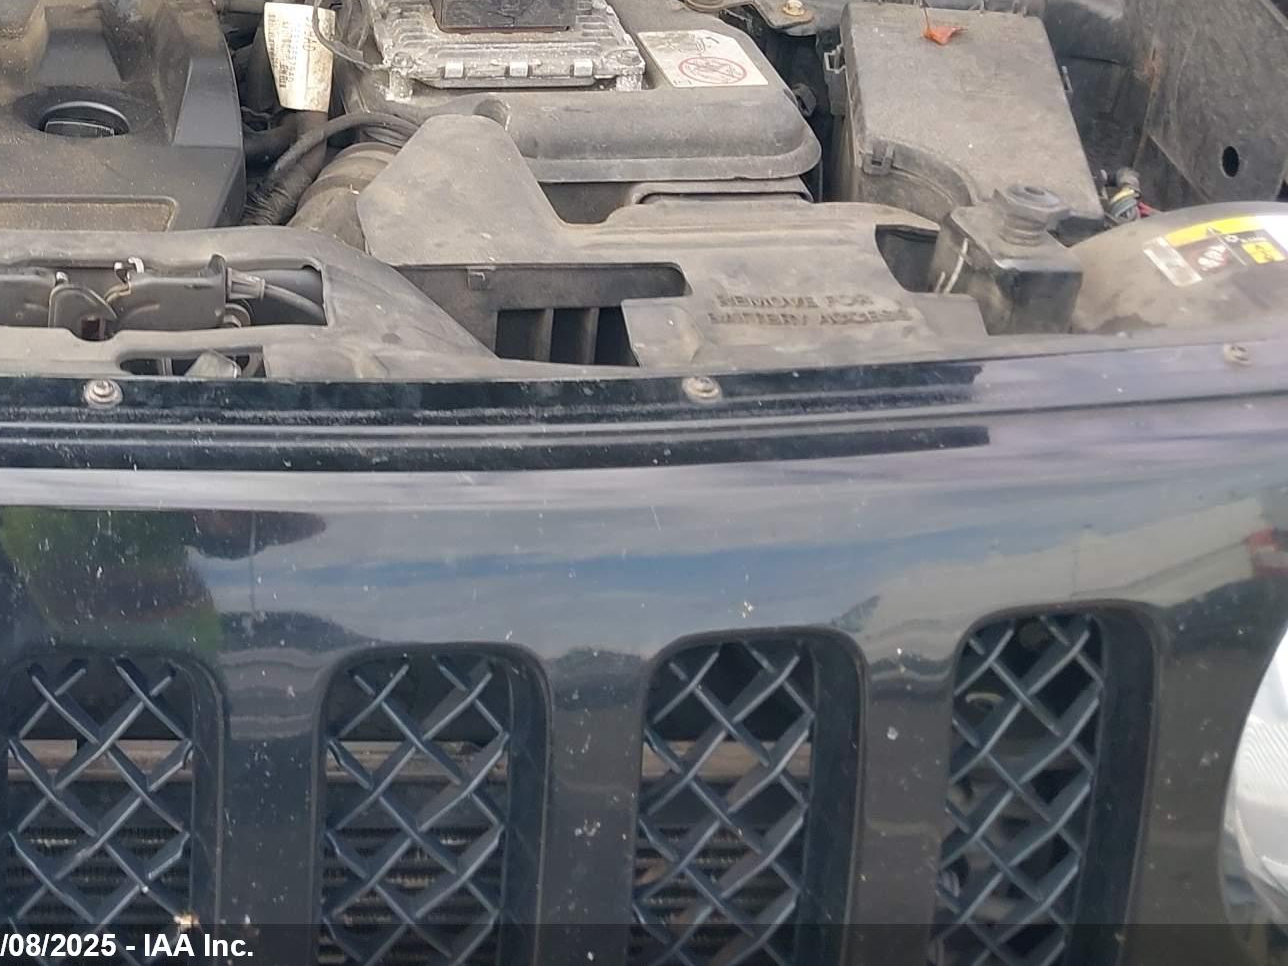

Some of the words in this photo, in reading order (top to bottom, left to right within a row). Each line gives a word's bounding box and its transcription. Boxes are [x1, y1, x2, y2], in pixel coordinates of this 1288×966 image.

[716, 295, 820, 309] REMOVE
[825, 293, 874, 307] FOR
[707, 312, 808, 326] BATTERY
[819, 308, 914, 326] ACCESS
